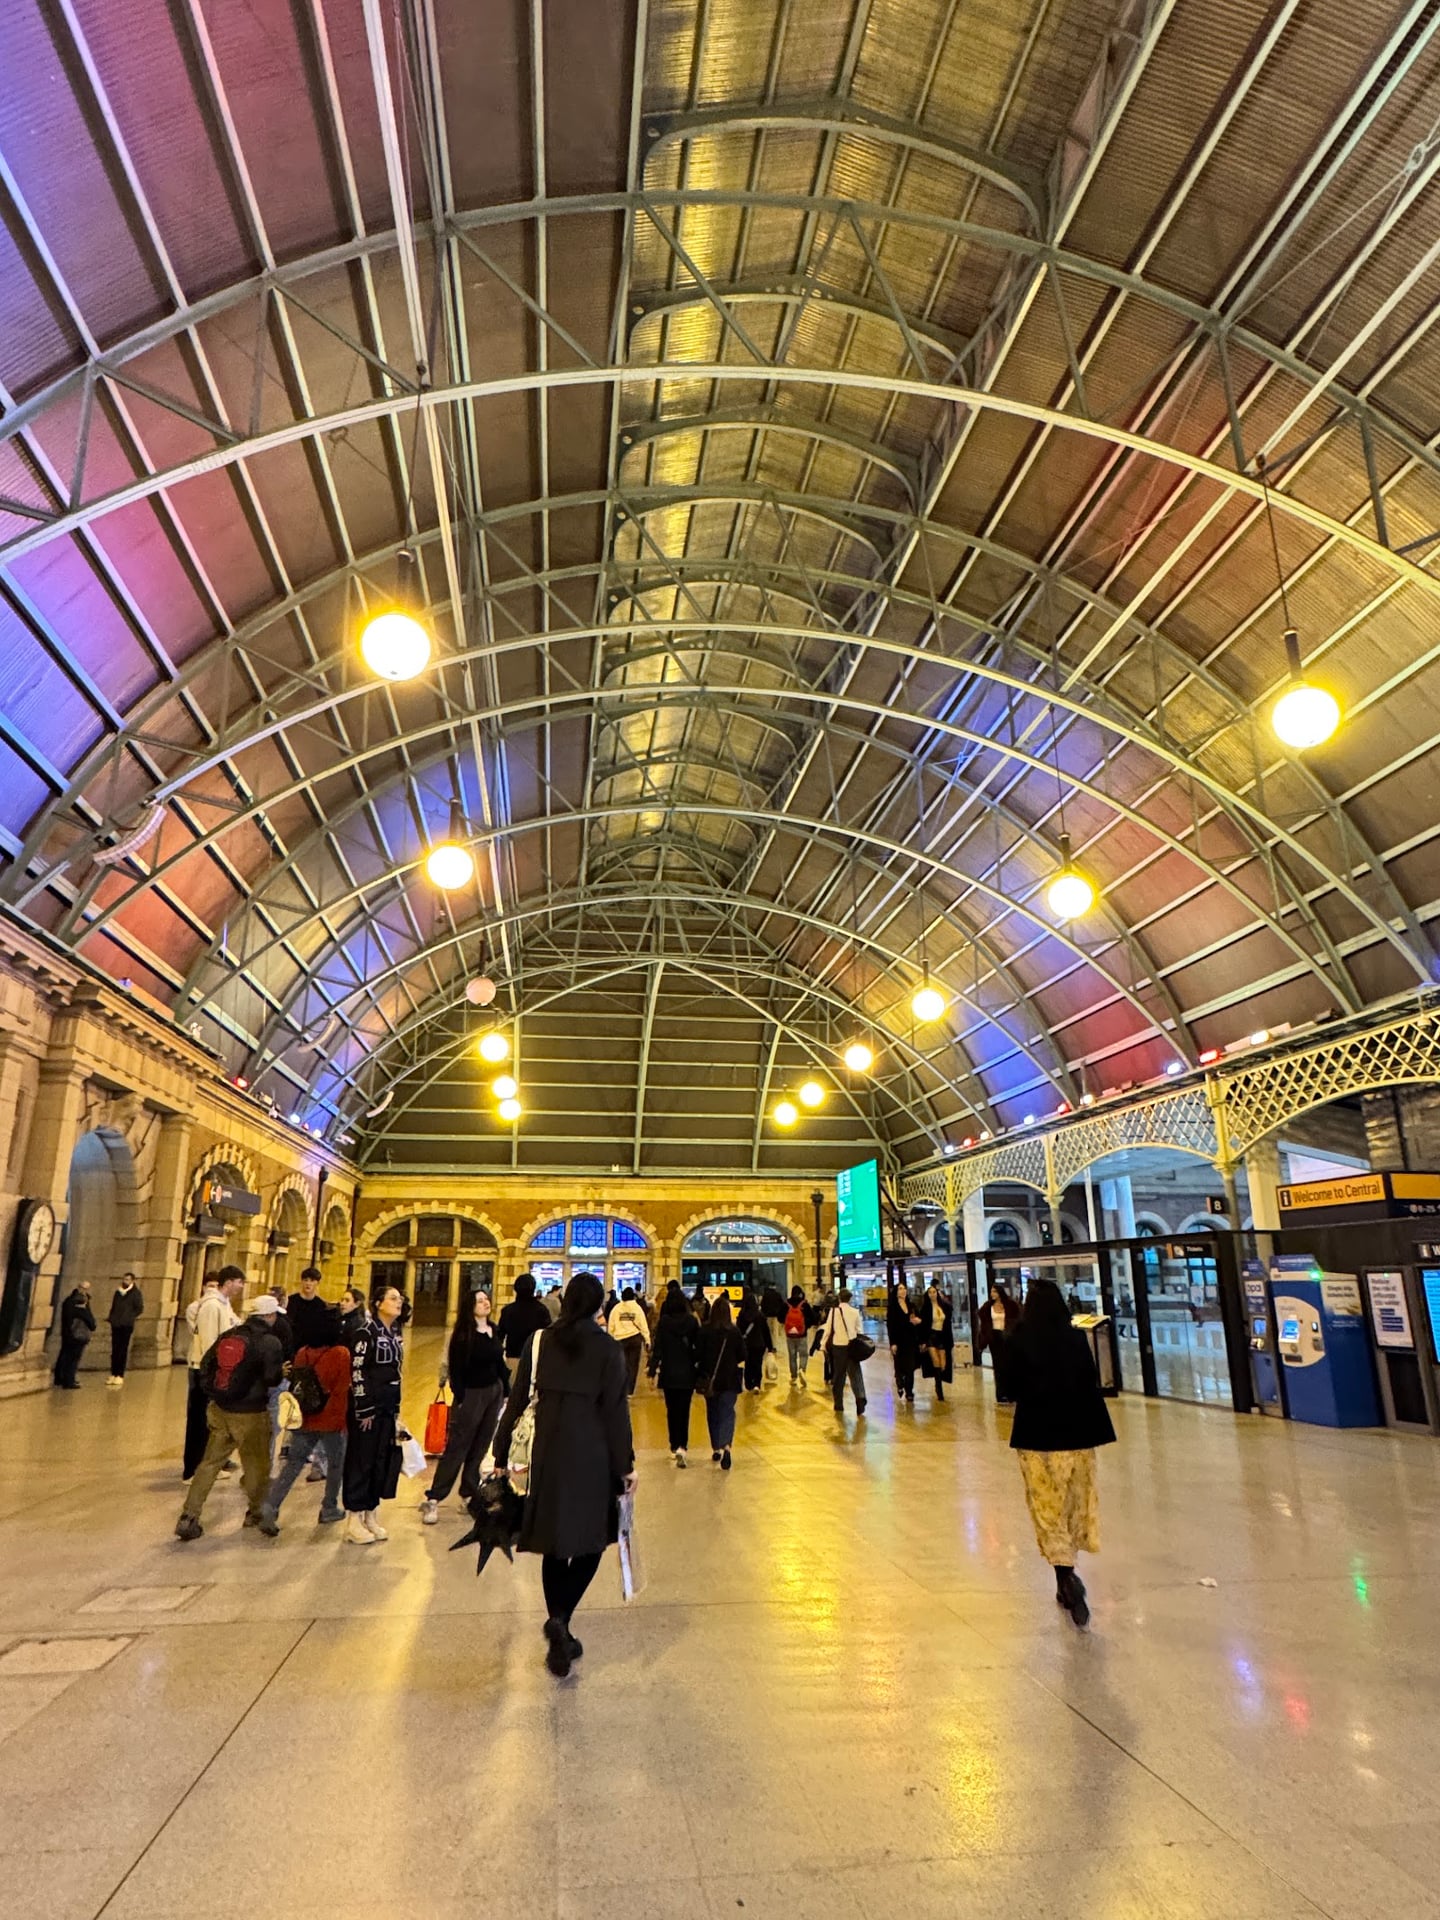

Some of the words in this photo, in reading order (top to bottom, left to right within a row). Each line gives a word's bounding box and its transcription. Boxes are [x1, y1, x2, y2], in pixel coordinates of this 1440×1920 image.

[1292, 1189, 1333, 1204] Welcome
[1334, 1188, 1344, 1199] to
[1345, 1180, 1381, 1197] Central
[1214, 1200, 1222, 1211] 8
[728, 1235, 742, 1244] Eddy
